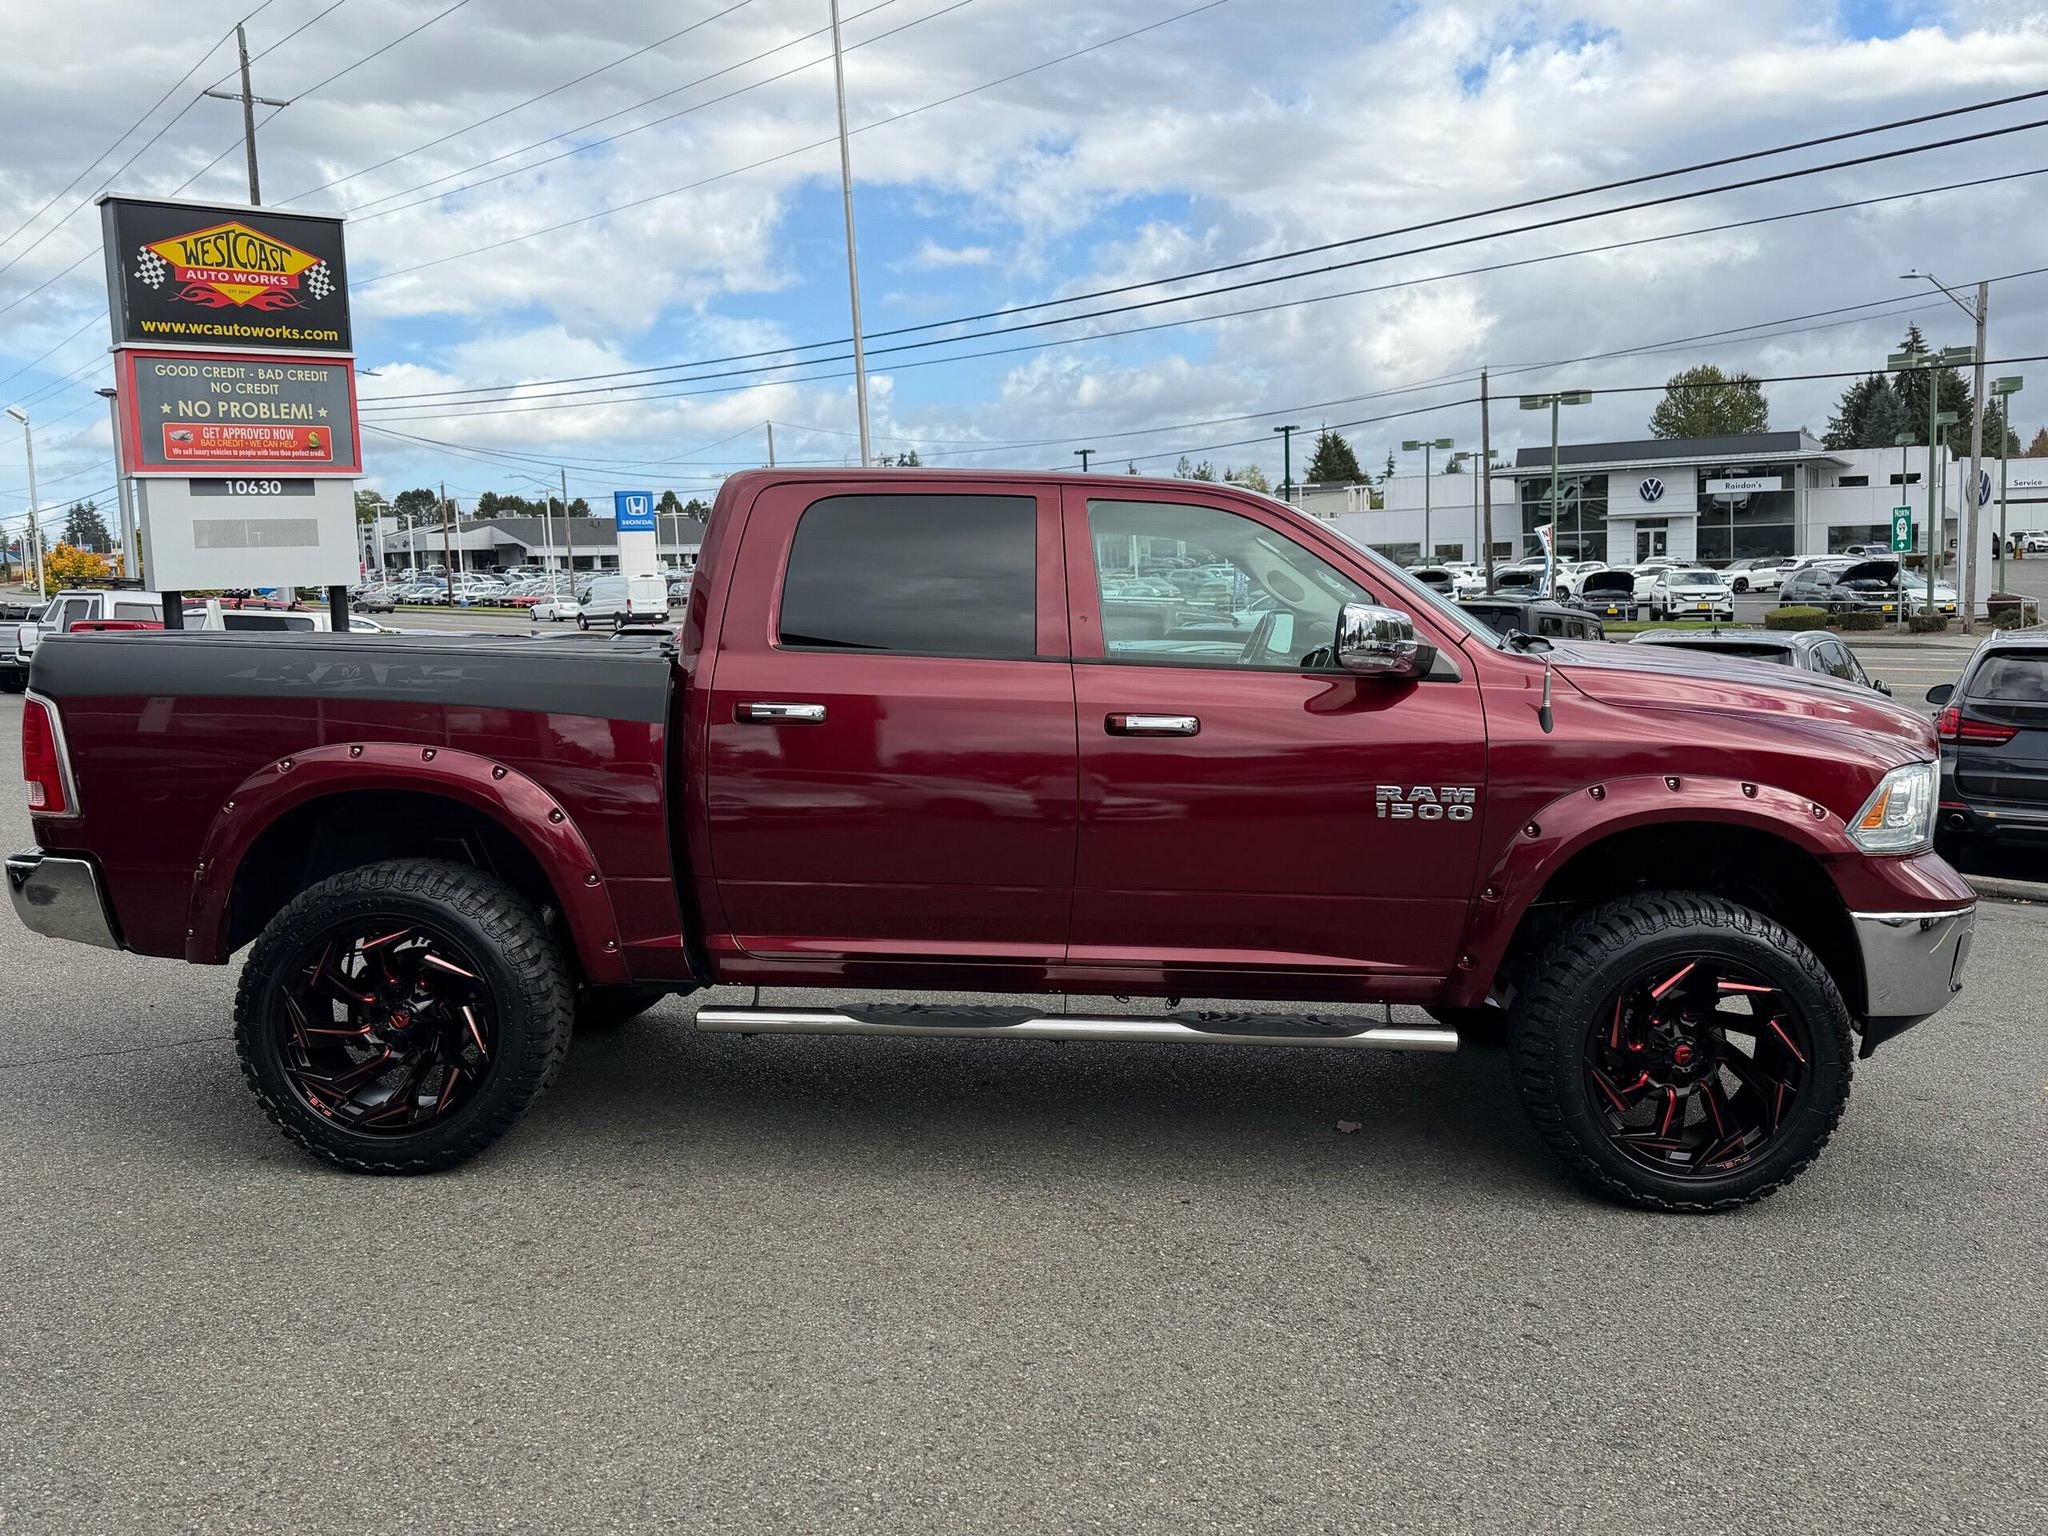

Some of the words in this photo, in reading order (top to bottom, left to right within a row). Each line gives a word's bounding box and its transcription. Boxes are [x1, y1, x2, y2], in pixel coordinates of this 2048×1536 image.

[186, 270, 230, 282] AUTO
[234, 273, 289, 286] WORKS
[141, 319, 339, 342] www.wcautoworks.com
[155, 364, 199, 377] GOOD
[202, 366, 246, 379] CREDIT
[258, 368, 284, 380] BAD
[287, 369, 329, 382] CREDIT
[210, 382, 232, 394] NO
[235, 383, 280, 395] CREDIT
[178, 400, 212, 418] NO
[217, 401, 314, 420] PROBLEM!
[203, 427, 221, 439] GET
[223, 427, 271, 440] APPROVED
[273, 428, 295, 440] NOW
[200, 439, 216, 447] BAD
[217, 439, 244, 448] CREDIT
[249, 440, 261, 448] WE
[262, 440, 279, 448] CAN
[280, 440, 299, 449] HELP
[225, 480, 282, 495] 10630
[1725, 481, 1762, 490] Rairdon's
[2013, 479, 2043, 487] Service
[1376, 785, 1476, 803] RAM
[1376, 802, 1474, 821] 1500
